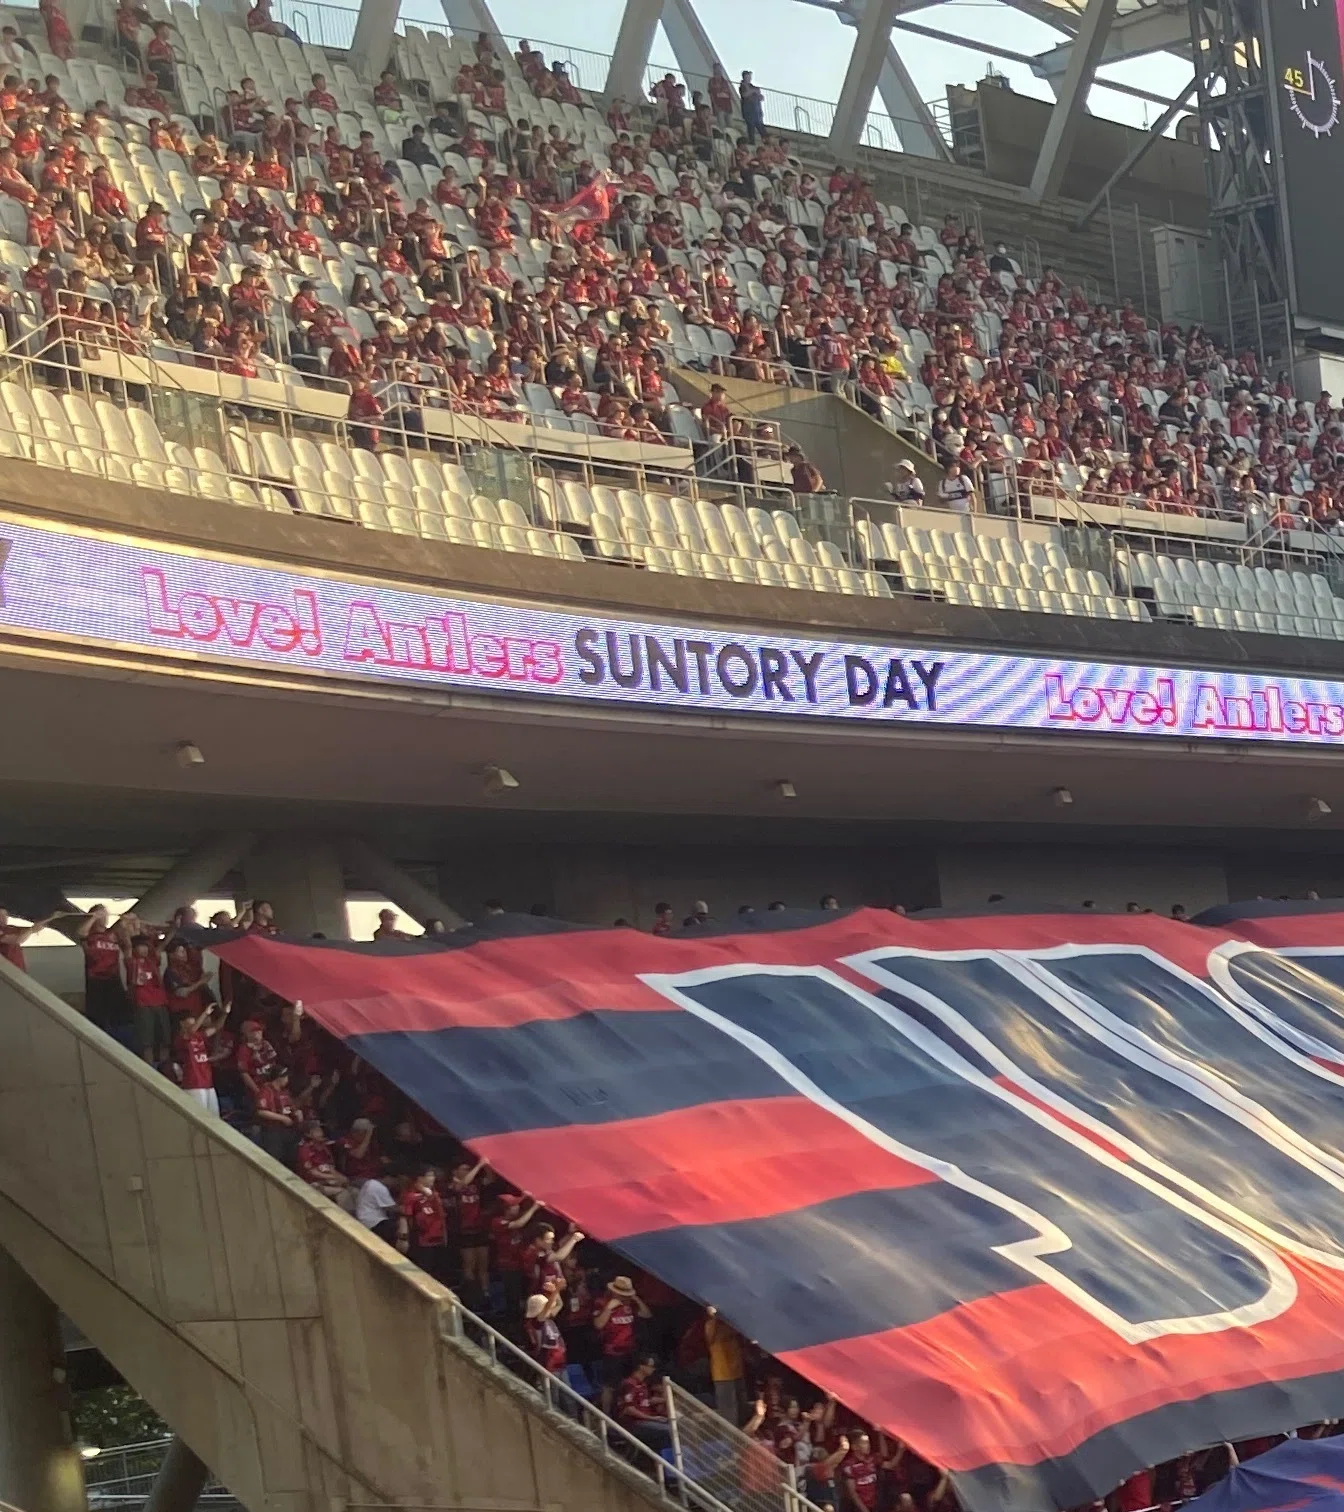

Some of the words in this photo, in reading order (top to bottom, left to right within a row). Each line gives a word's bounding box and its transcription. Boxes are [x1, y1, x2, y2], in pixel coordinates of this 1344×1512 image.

[141, 567, 322, 658] Love!
[343, 600, 565, 686] Antlers
[574, 628, 825, 706] SUNTORY
[847, 655, 945, 713] DAY
[1045, 673, 1177, 728] Love!
